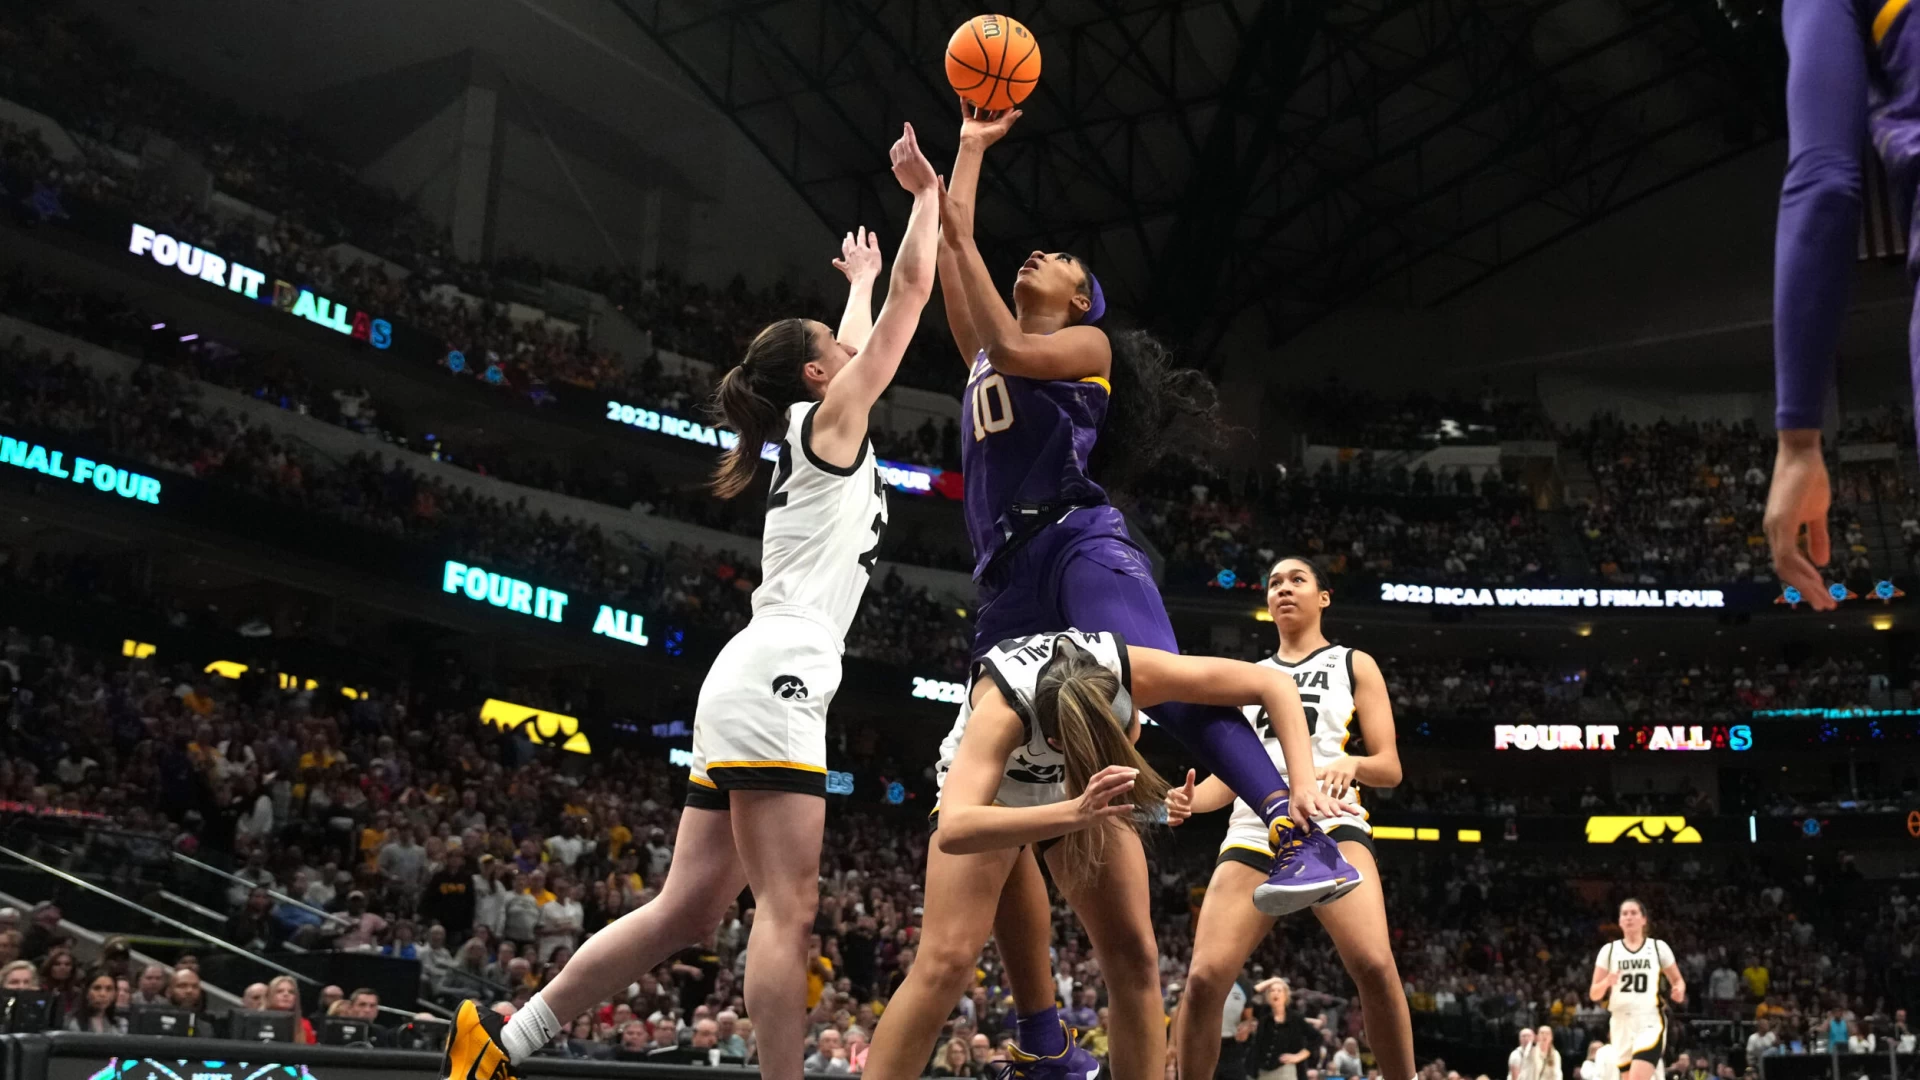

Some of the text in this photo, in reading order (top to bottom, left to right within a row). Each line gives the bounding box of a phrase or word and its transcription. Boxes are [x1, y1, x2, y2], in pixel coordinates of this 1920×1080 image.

[129, 223, 227, 287] FOUR
[229, 262, 266, 299] IT
[606, 401, 661, 431] 2023
[660, 415, 719, 447] NCAA
[971, 373, 1014, 442] 10
[0, 434, 161, 504] NAL FOUR
[443, 560, 533, 614] FOUR
[534, 586, 569, 623] IT
[1381, 583, 1725, 607] 2023 NCAA WOMEN'S FINAL FOUR
[1494, 724, 1584, 750] FOUR
[1586, 725, 1620, 750] IT
[826, 770, 854, 795] ES
[1618, 959, 1651, 970] IOWA
[1620, 973, 1648, 993] 20
